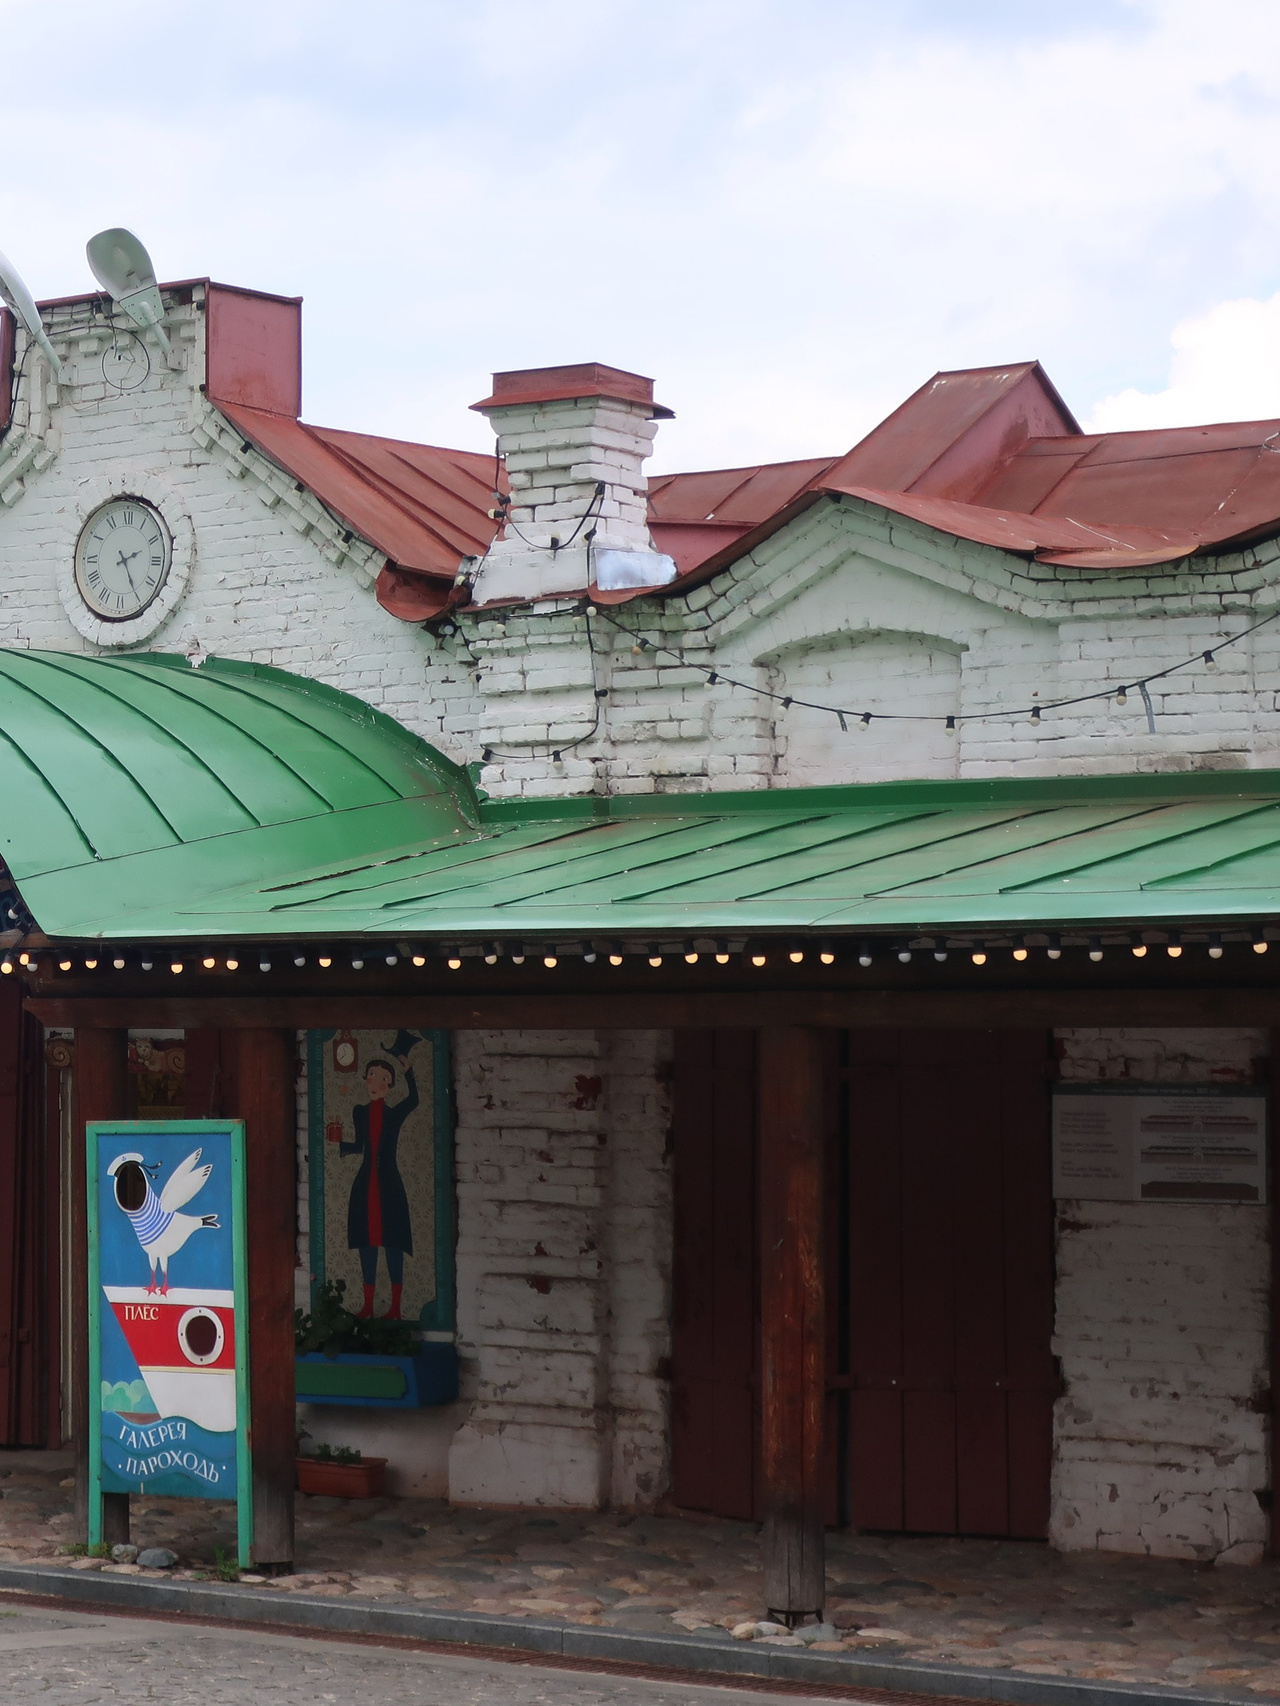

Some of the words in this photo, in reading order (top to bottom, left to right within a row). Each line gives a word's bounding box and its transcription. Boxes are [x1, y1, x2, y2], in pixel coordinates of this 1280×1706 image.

[124, 1305, 159, 1321] ПЛЁС
[119, 1422, 187, 1449] ГАЛЕРЕЯ
[126, 1450, 219, 1483] ПАРОХОДЪ
